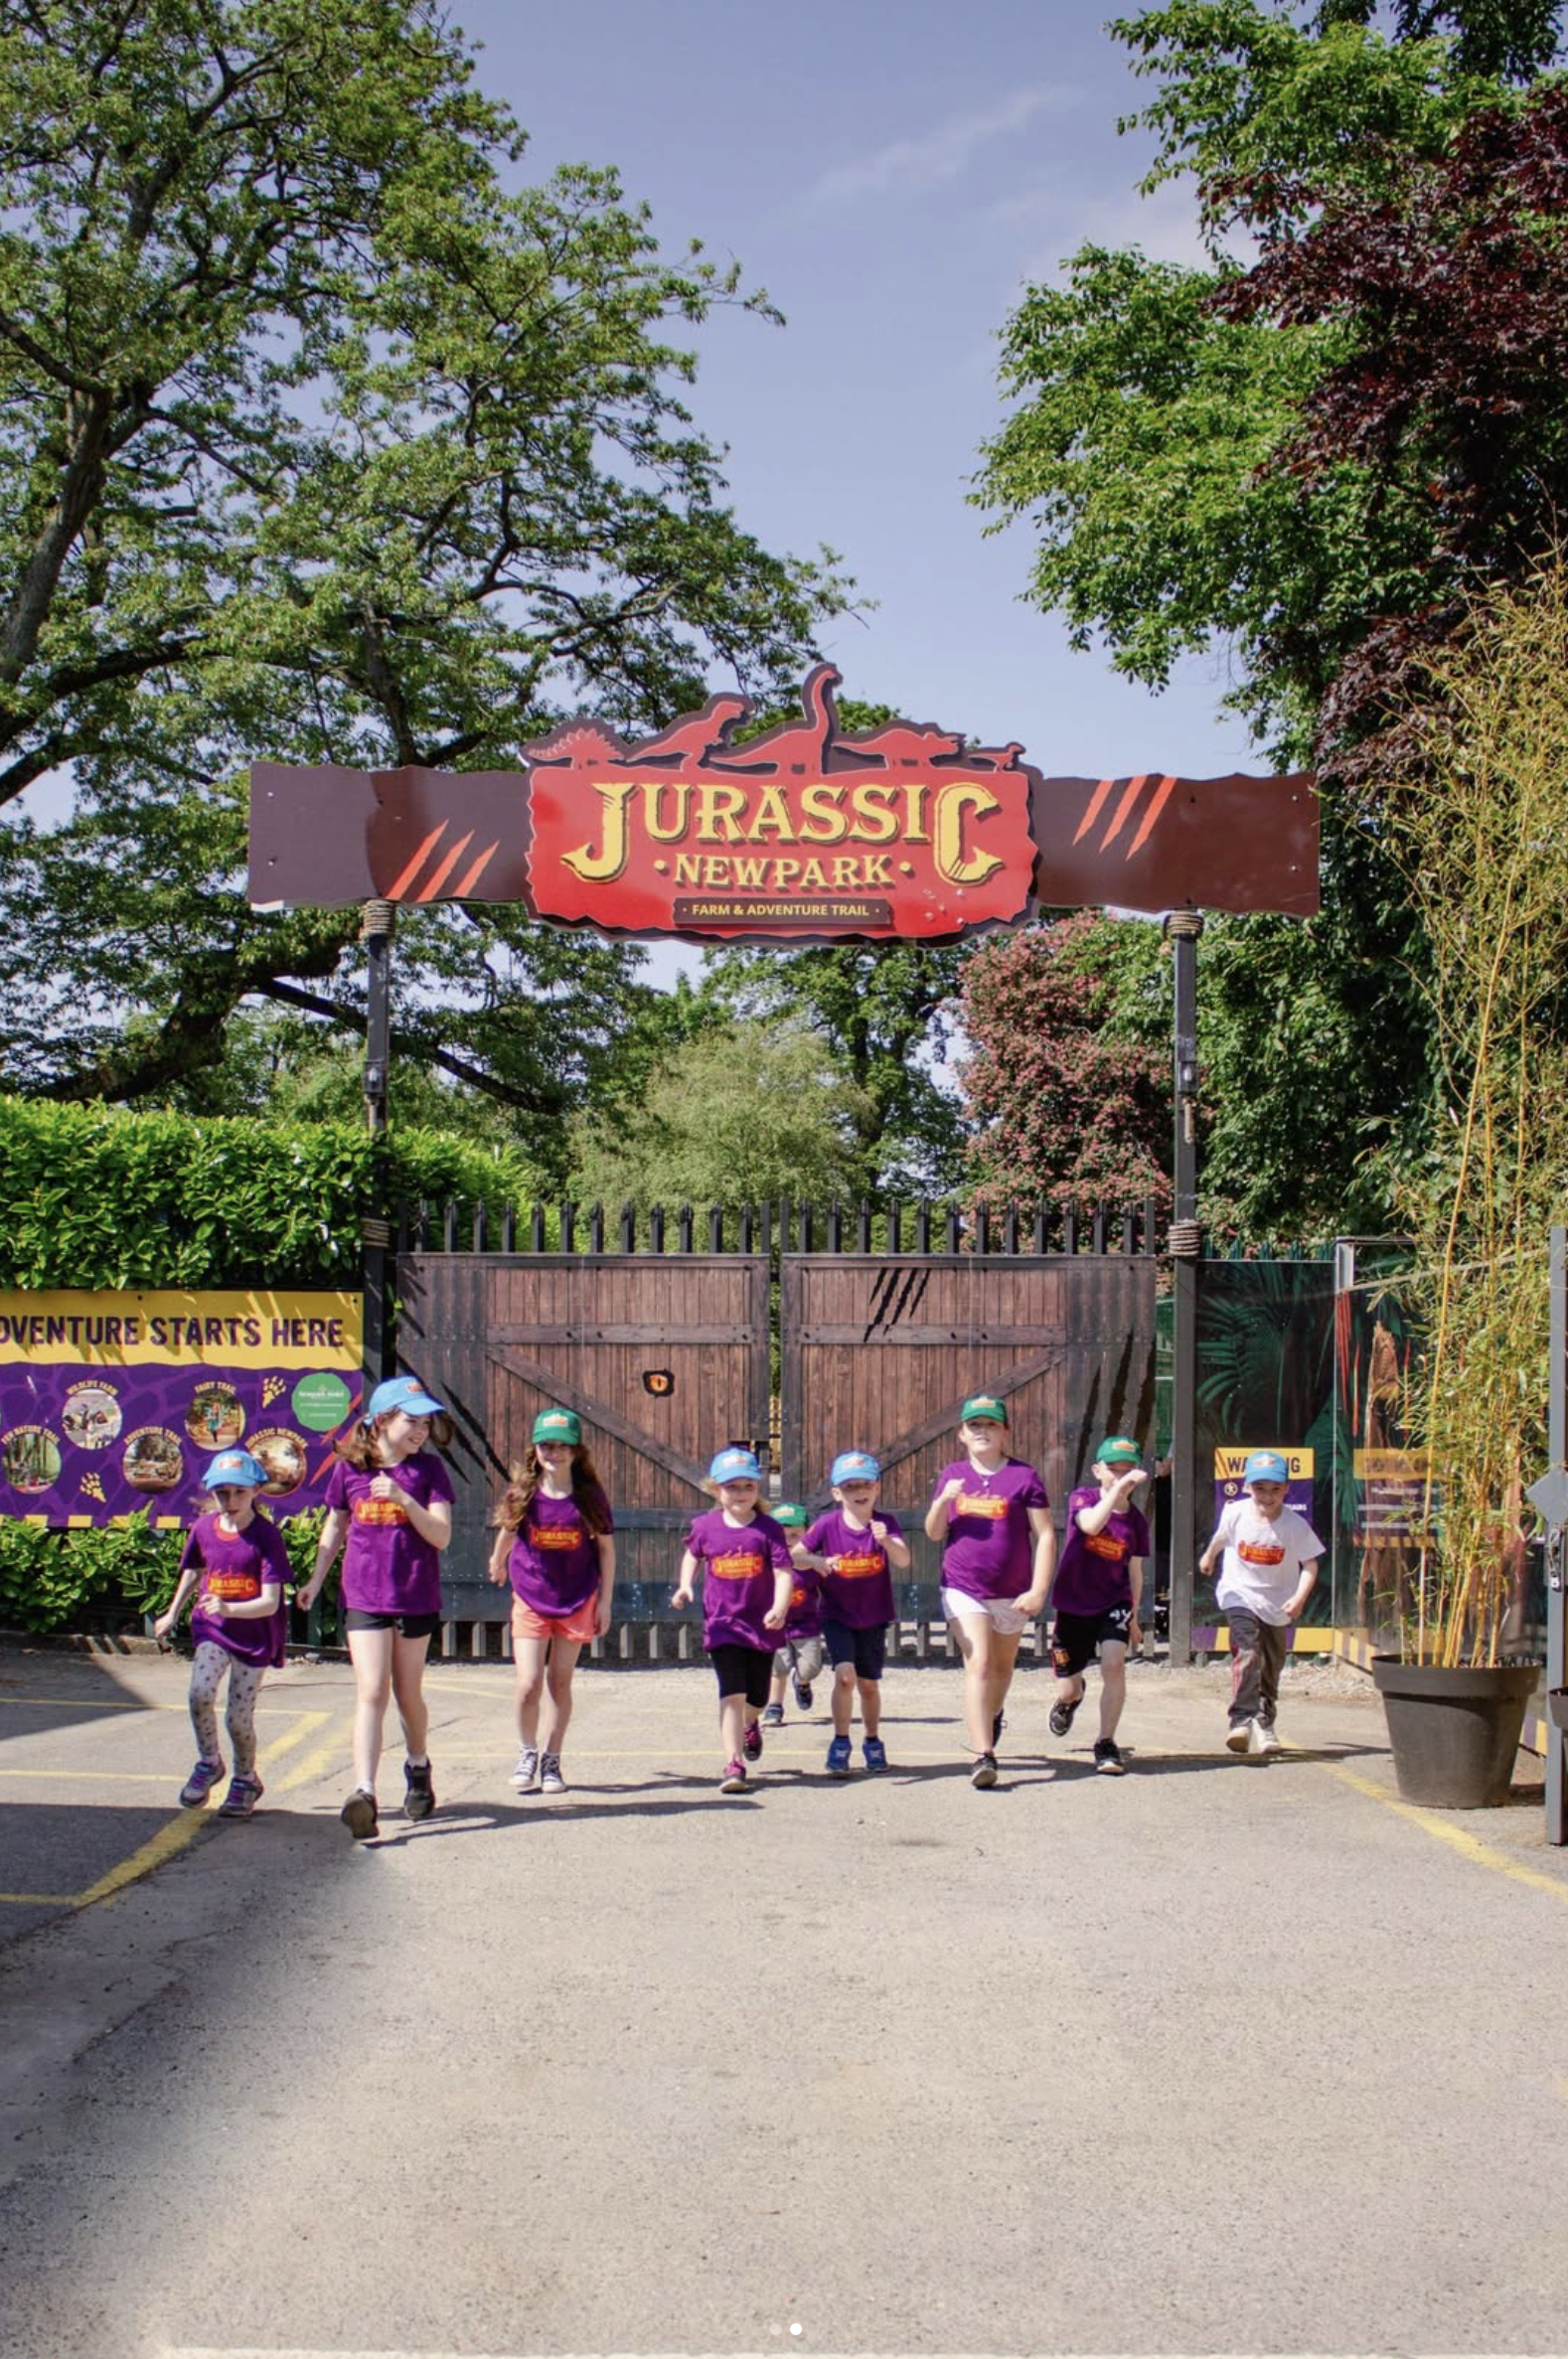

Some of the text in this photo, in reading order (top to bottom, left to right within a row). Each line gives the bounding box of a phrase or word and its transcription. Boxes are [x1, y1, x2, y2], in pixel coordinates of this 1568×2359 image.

[559, 780, 1005, 886] JURASSIC
[675, 854, 896, 889] NEWPARK
[692, 904, 869, 916] FARM & ADVENTURE TRAIL
[150, 1317, 261, 1347] STARTS
[271, 1318, 344, 1347] HERE
